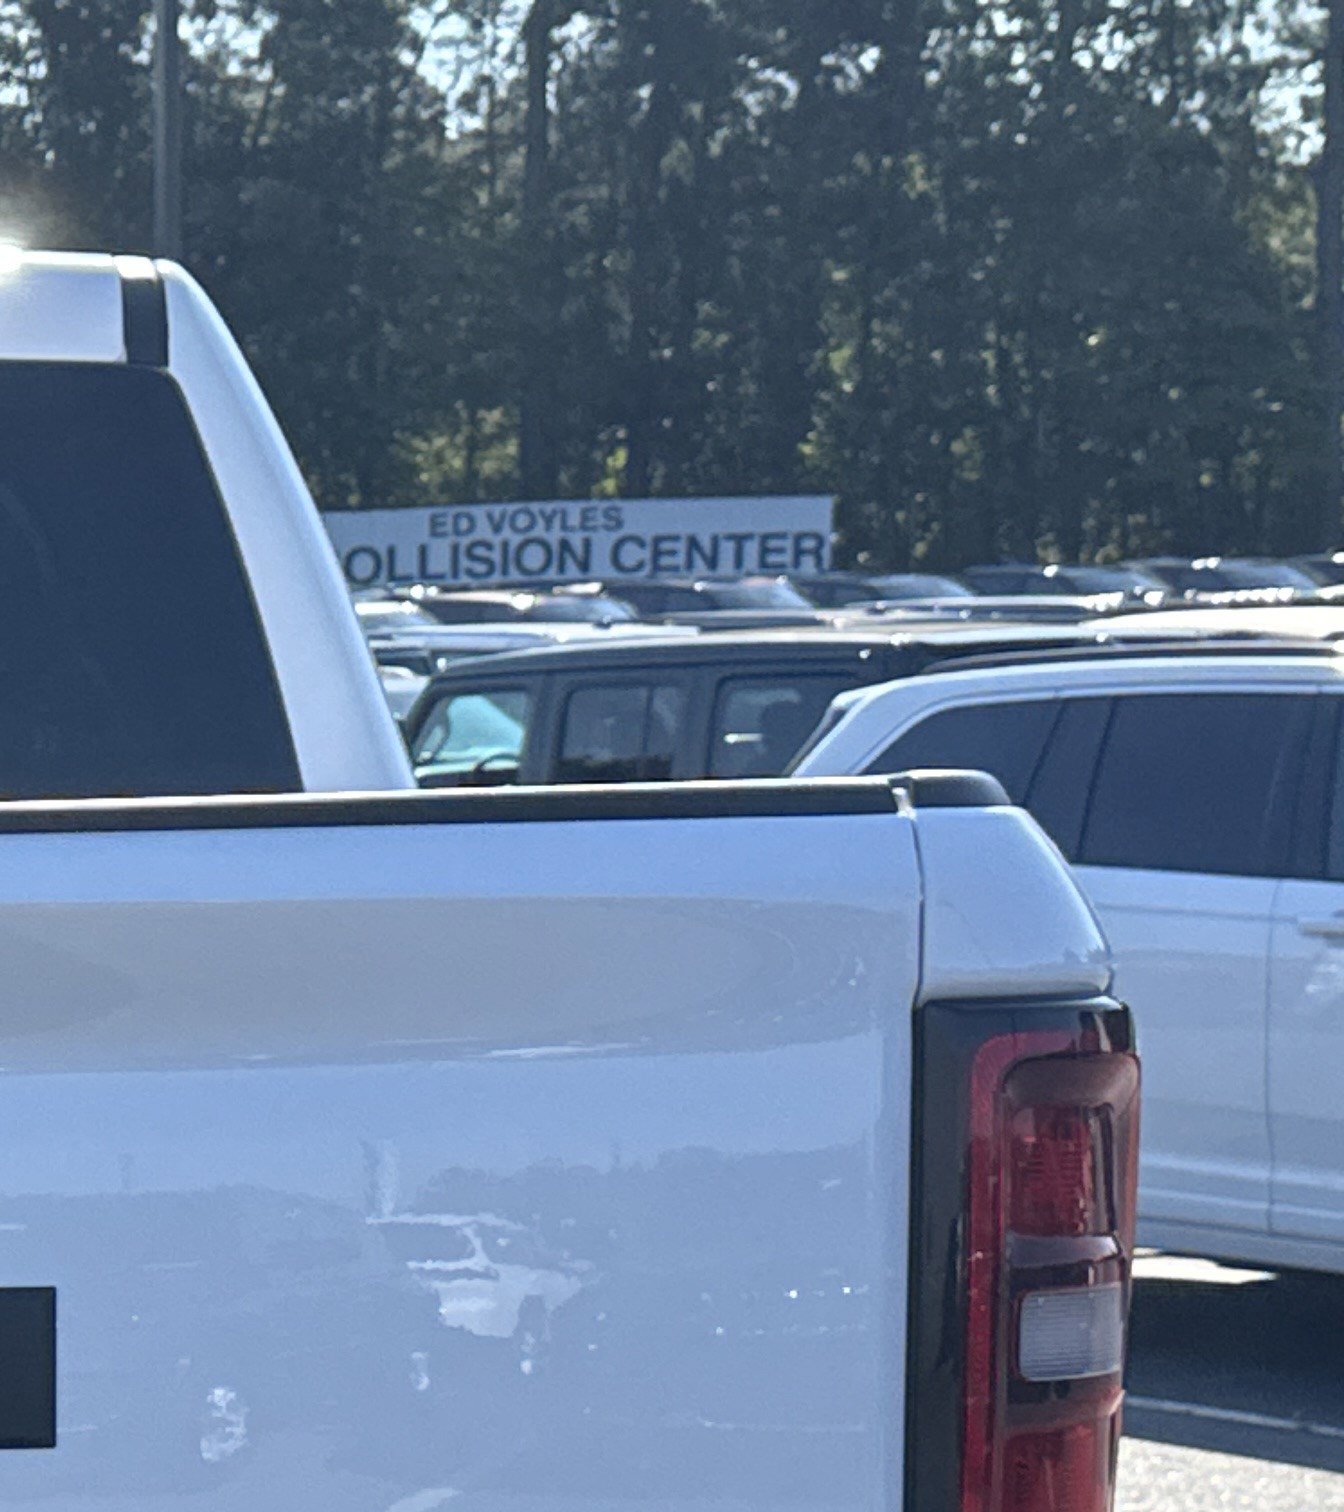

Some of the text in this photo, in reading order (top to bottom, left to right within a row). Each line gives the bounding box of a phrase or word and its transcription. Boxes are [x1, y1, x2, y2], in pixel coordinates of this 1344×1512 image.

[429, 506, 624, 538] ED VOYLES
[343, 532, 828, 585] OLLISION CENTER
